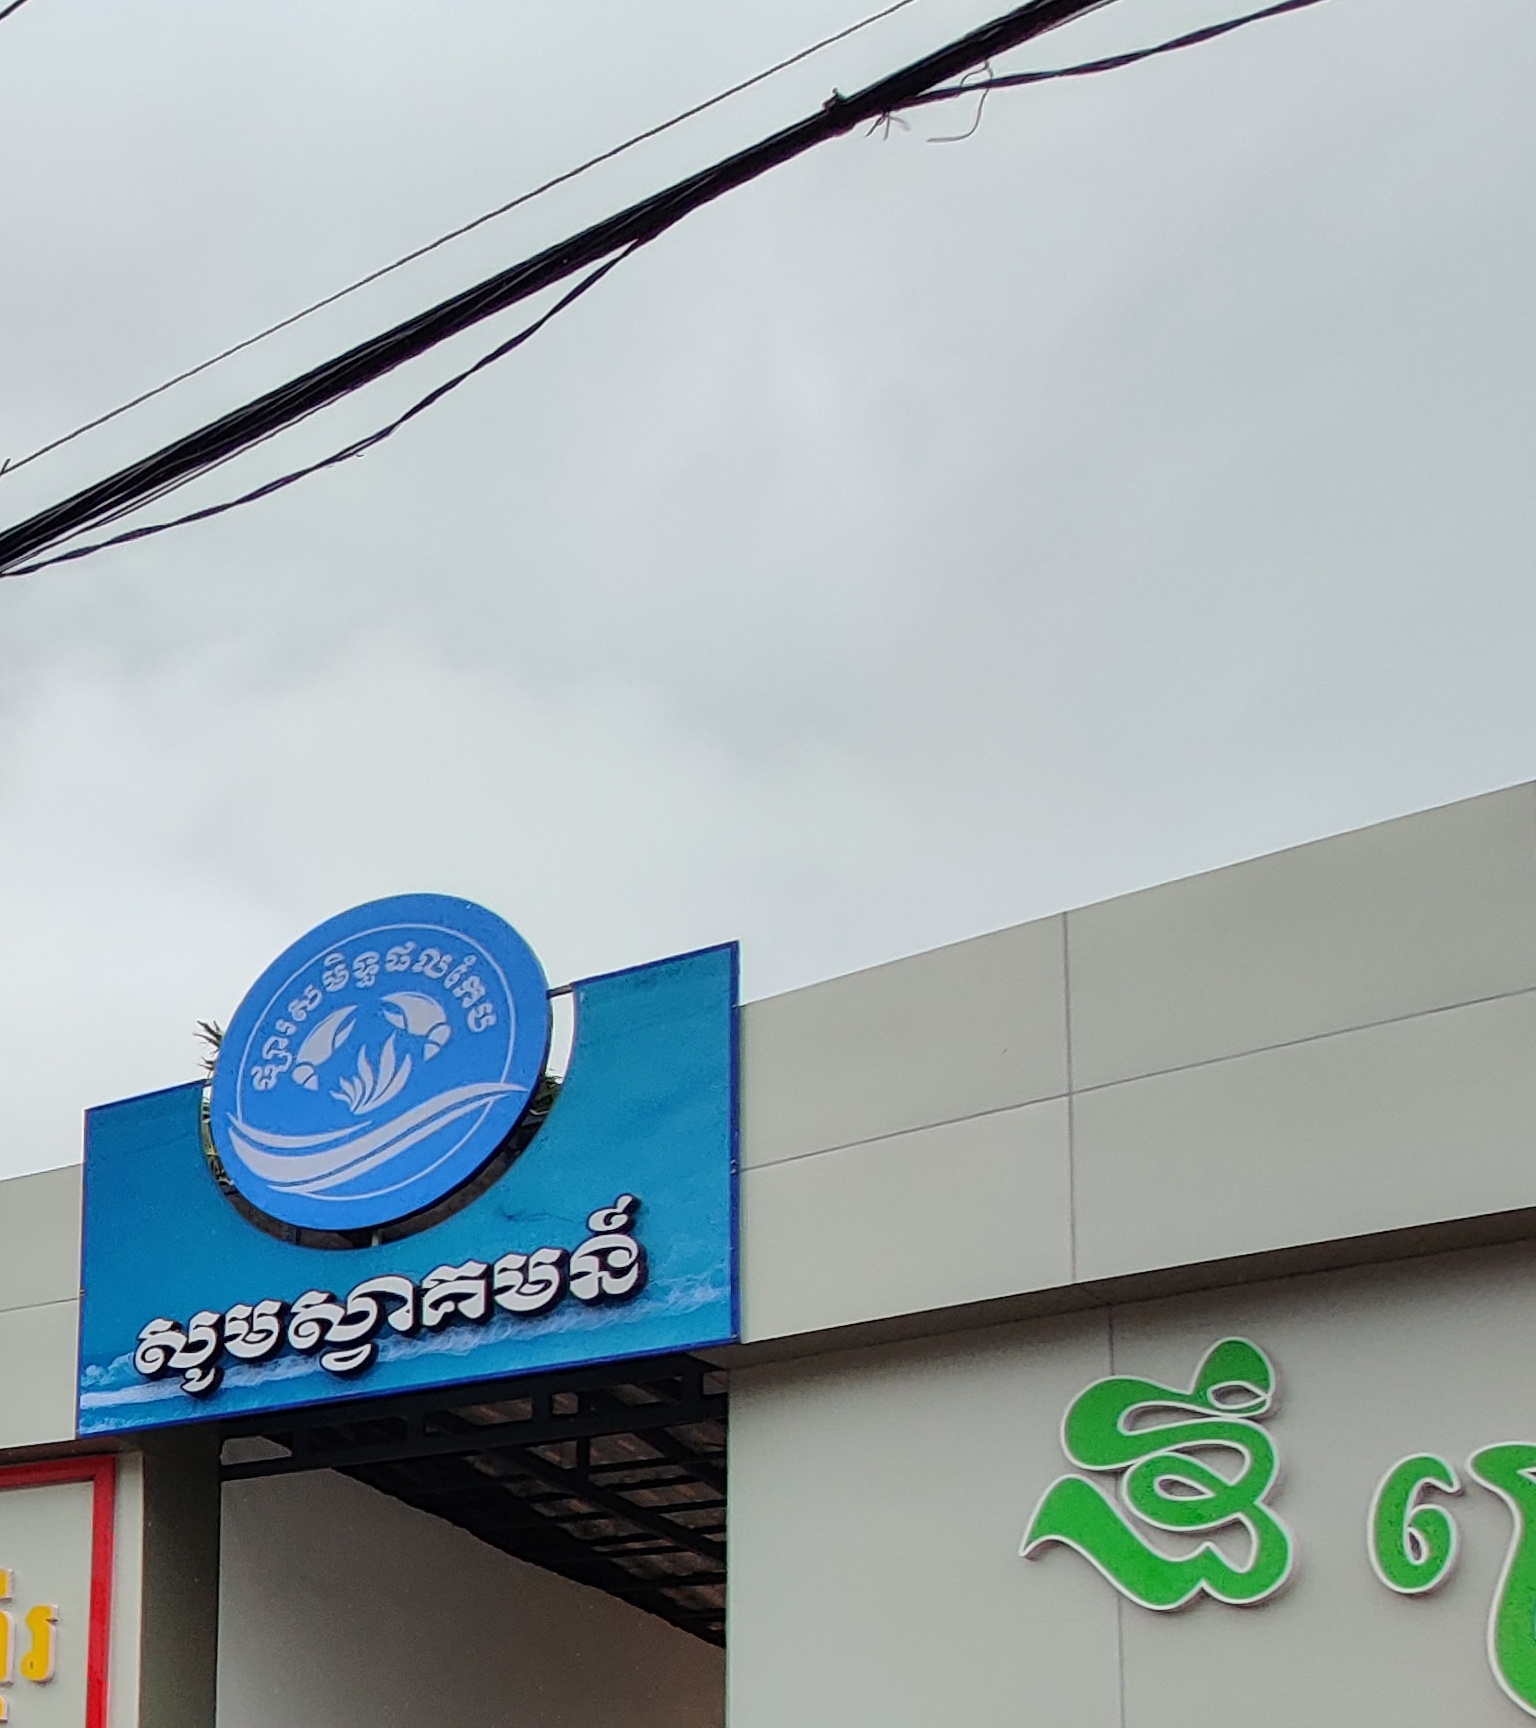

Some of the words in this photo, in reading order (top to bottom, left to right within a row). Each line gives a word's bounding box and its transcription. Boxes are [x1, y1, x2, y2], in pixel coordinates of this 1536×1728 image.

[134, 1194, 642, 1396] សូមស្វាគមន៍
